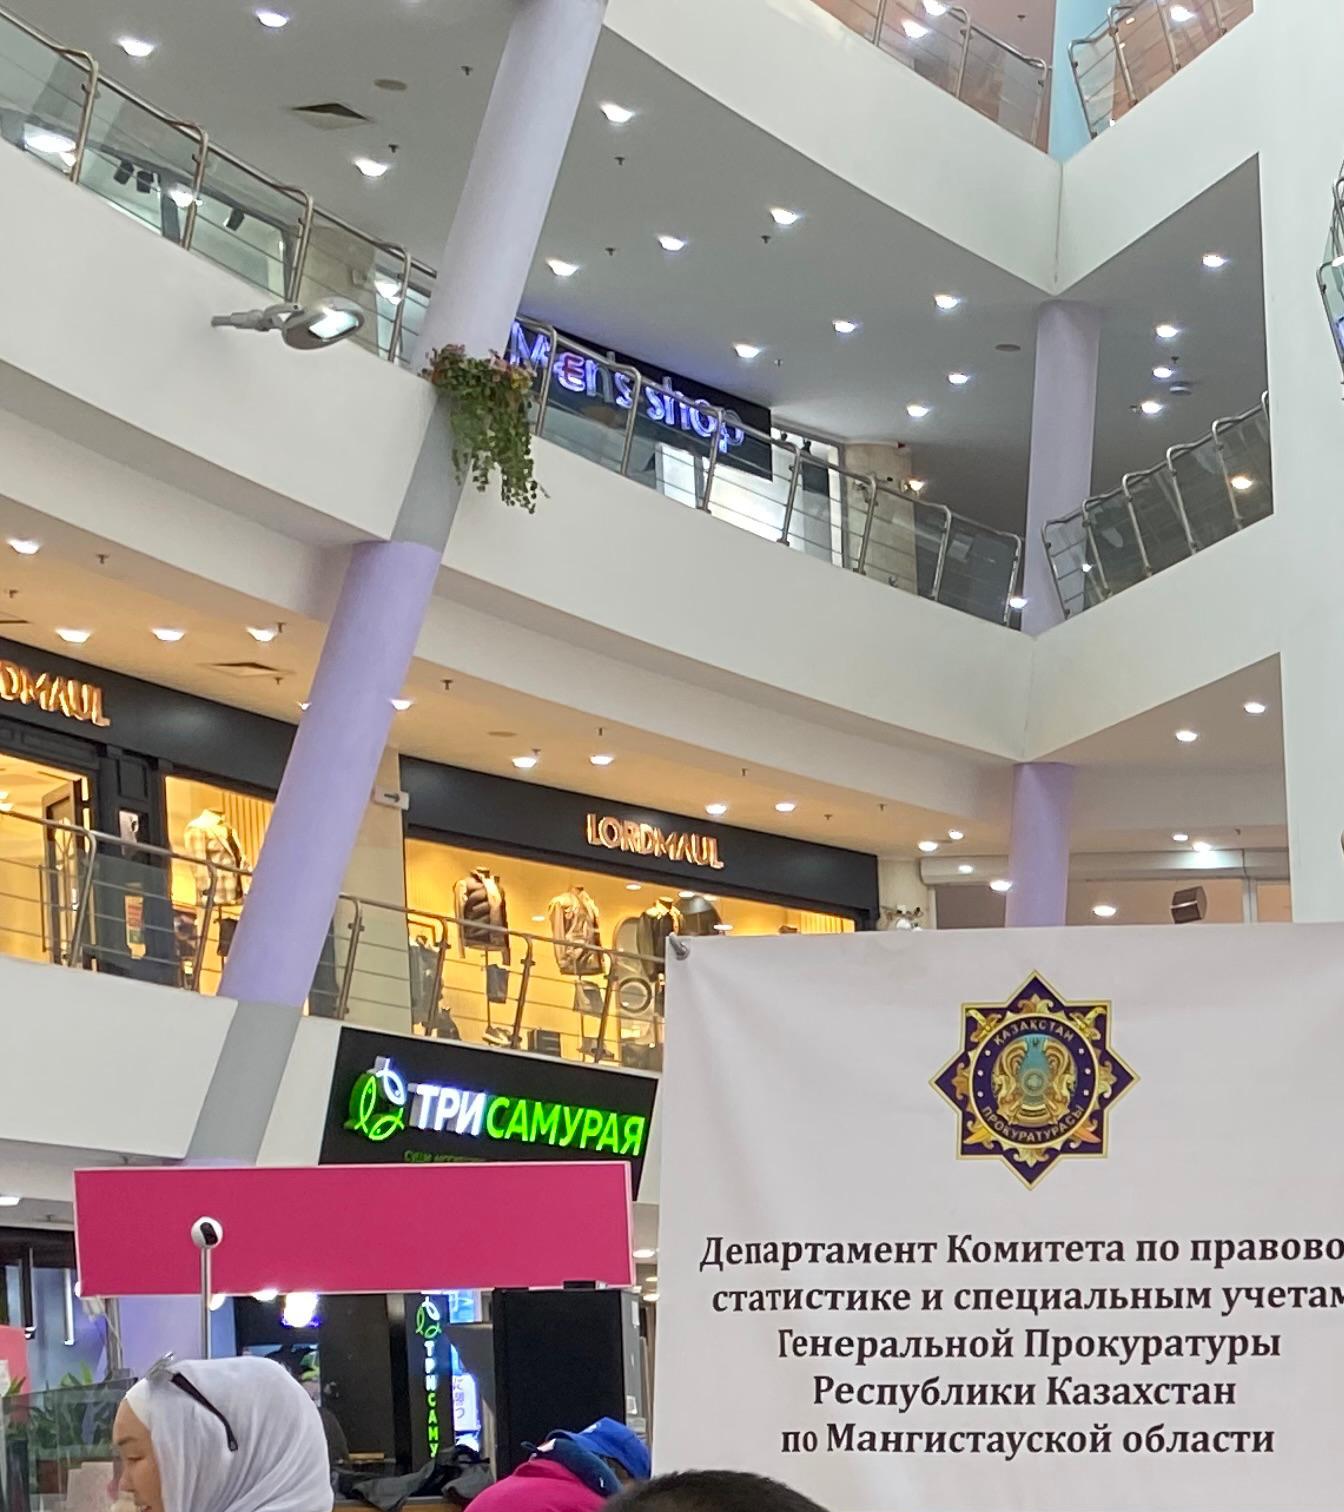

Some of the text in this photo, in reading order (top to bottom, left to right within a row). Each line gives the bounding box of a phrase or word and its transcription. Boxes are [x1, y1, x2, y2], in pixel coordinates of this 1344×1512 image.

[586, 813, 724, 869] LORDMAUL
[700, 1237, 937, 1272] Департамент
[947, 1235, 1125, 1262] Комитета
[1136, 1240, 1179, 1261] по
[713, 1289, 910, 1311] статистике
[922, 1290, 943, 1310] и
[955, 1288, 1211, 1315] специальным
[779, 1328, 1280, 1366] Генеральной Прокуратуры
[814, 1376, 1235, 1413] Республики Казахстан
[782, 1424, 1274, 1461] по Мангистауской области
